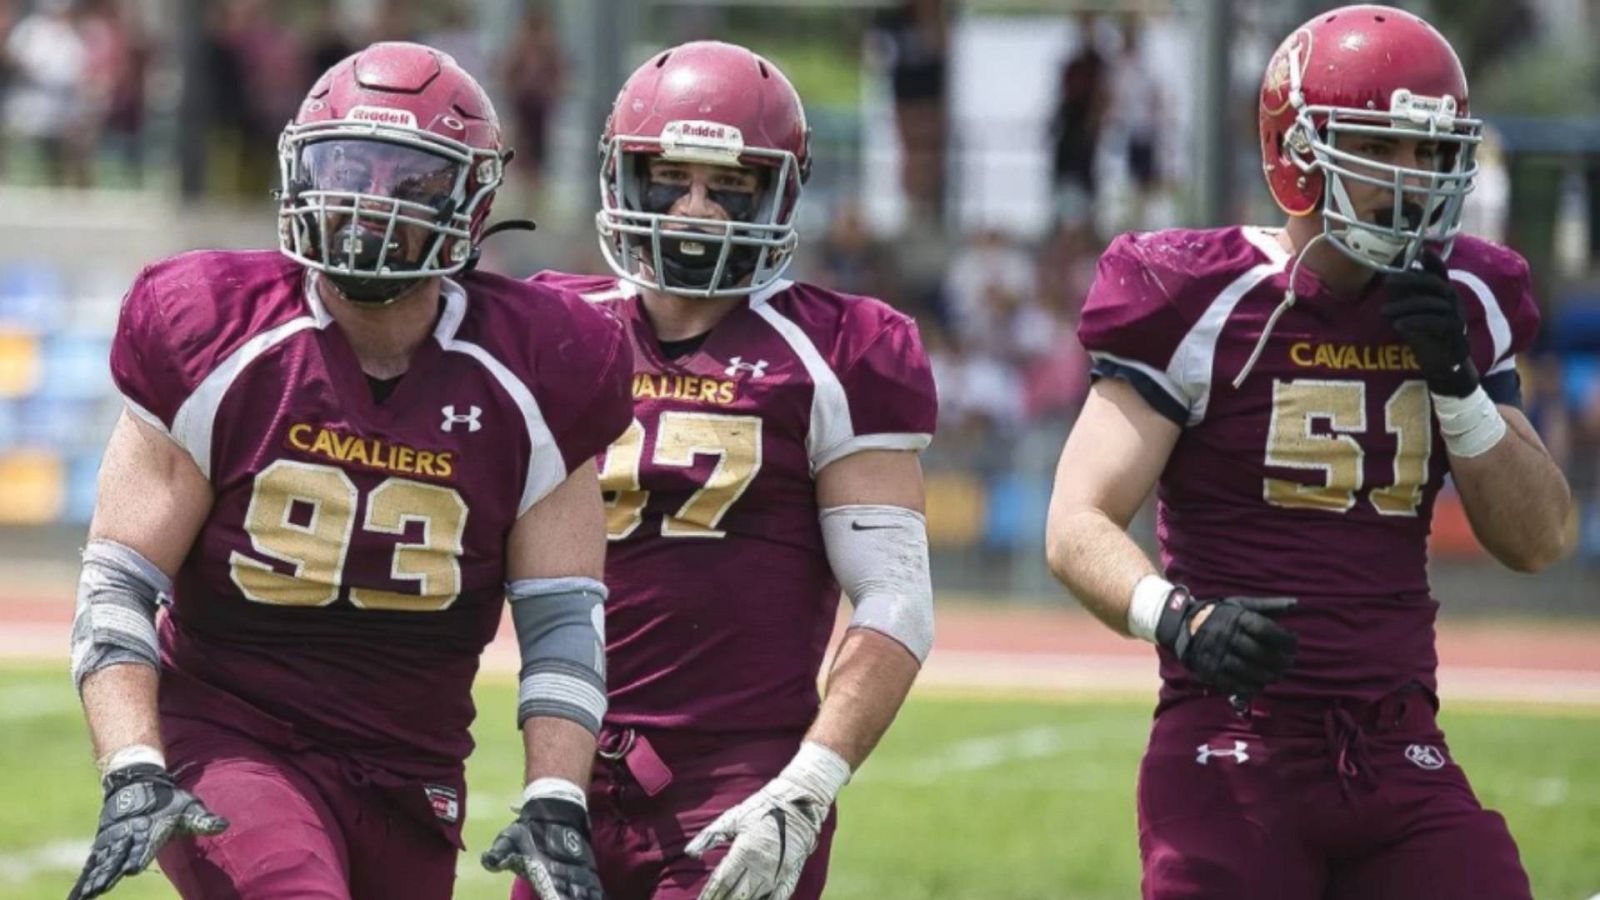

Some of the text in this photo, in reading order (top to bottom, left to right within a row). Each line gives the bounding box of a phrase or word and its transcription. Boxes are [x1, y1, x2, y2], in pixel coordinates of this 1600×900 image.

[682, 123, 725, 139] Riddell
[1290, 342, 1421, 370] CAVALIER
[632, 373, 735, 404] ALIERS
[288, 423, 453, 478] CAVALIERS
[1263, 378, 1433, 517] 51
[229, 458, 469, 611] 93
